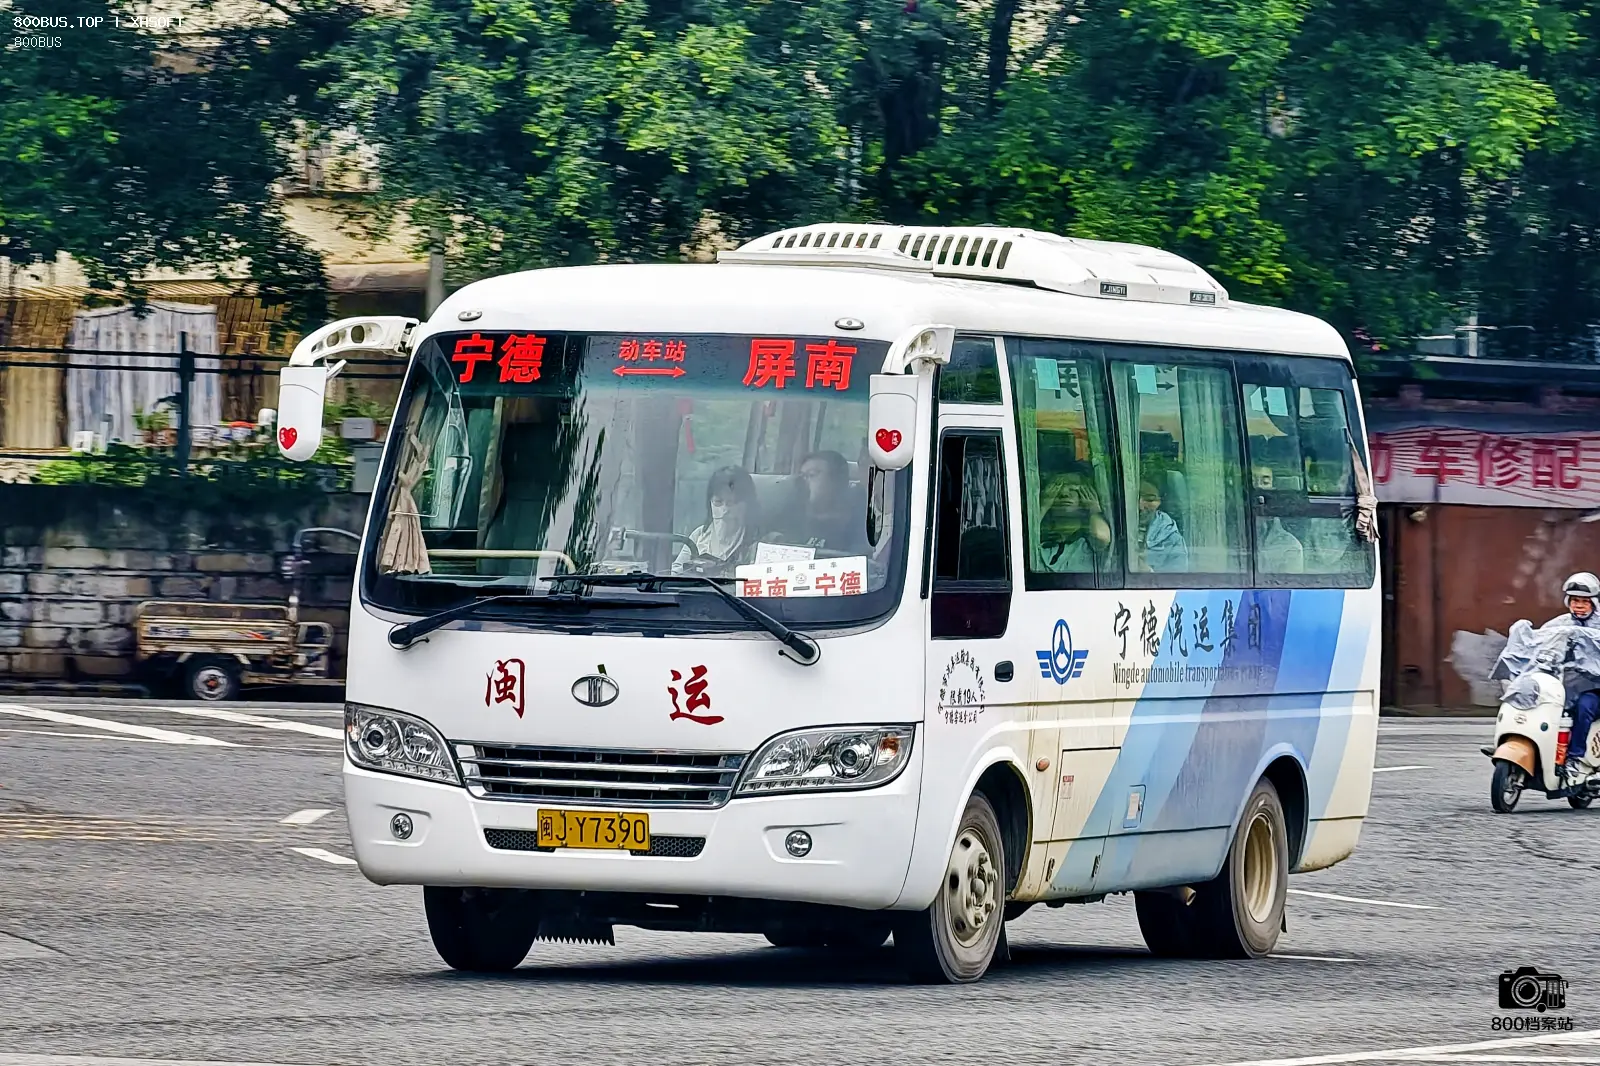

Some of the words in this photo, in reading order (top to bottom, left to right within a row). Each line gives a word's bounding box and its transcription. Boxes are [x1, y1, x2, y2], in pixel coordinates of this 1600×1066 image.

[451, 333, 547, 383] 宁德
[618, 340, 687, 362] 动车站
[742, 338, 857, 389] 屏南
[1113, 599, 1262, 660] 宁德汽运集团
[485, 658, 526, 719] 闽
[667, 664, 725, 726] 运
[1112, 662, 1140, 690] Ningde
[1140, 661, 1184, 684] automobile
